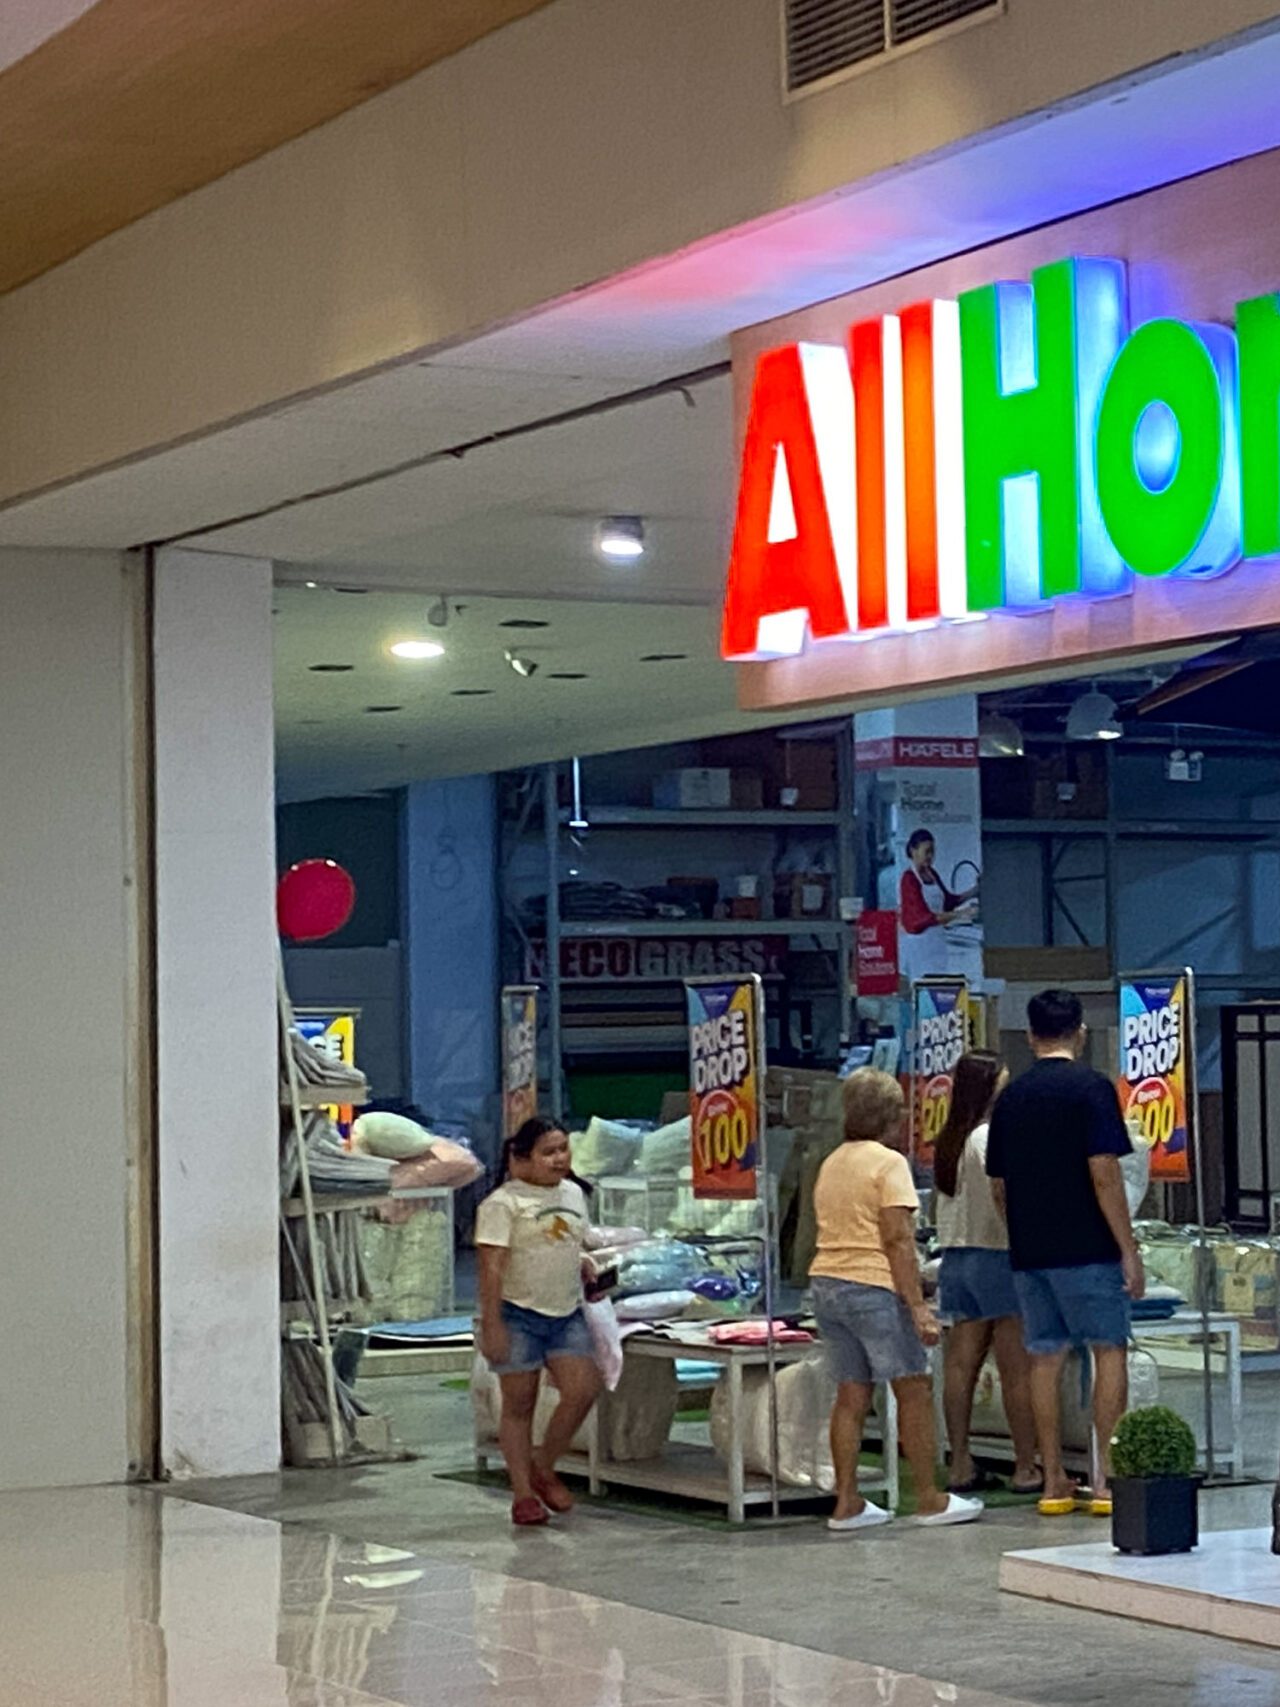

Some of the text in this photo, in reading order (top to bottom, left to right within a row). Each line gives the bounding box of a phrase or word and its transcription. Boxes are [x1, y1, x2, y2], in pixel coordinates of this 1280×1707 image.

[637, 940, 766, 977] GRASS
[691, 1010, 746, 1059] PRICE
[920, 1009, 964, 1048] PRICE
[1124, 1002, 1180, 1048] PRICE
[694, 1047, 748, 1094] DROP
[922, 1039, 964, 1076] DROP
[1126, 1037, 1180, 1081] DROP
[698, 1109, 748, 1171] 100
